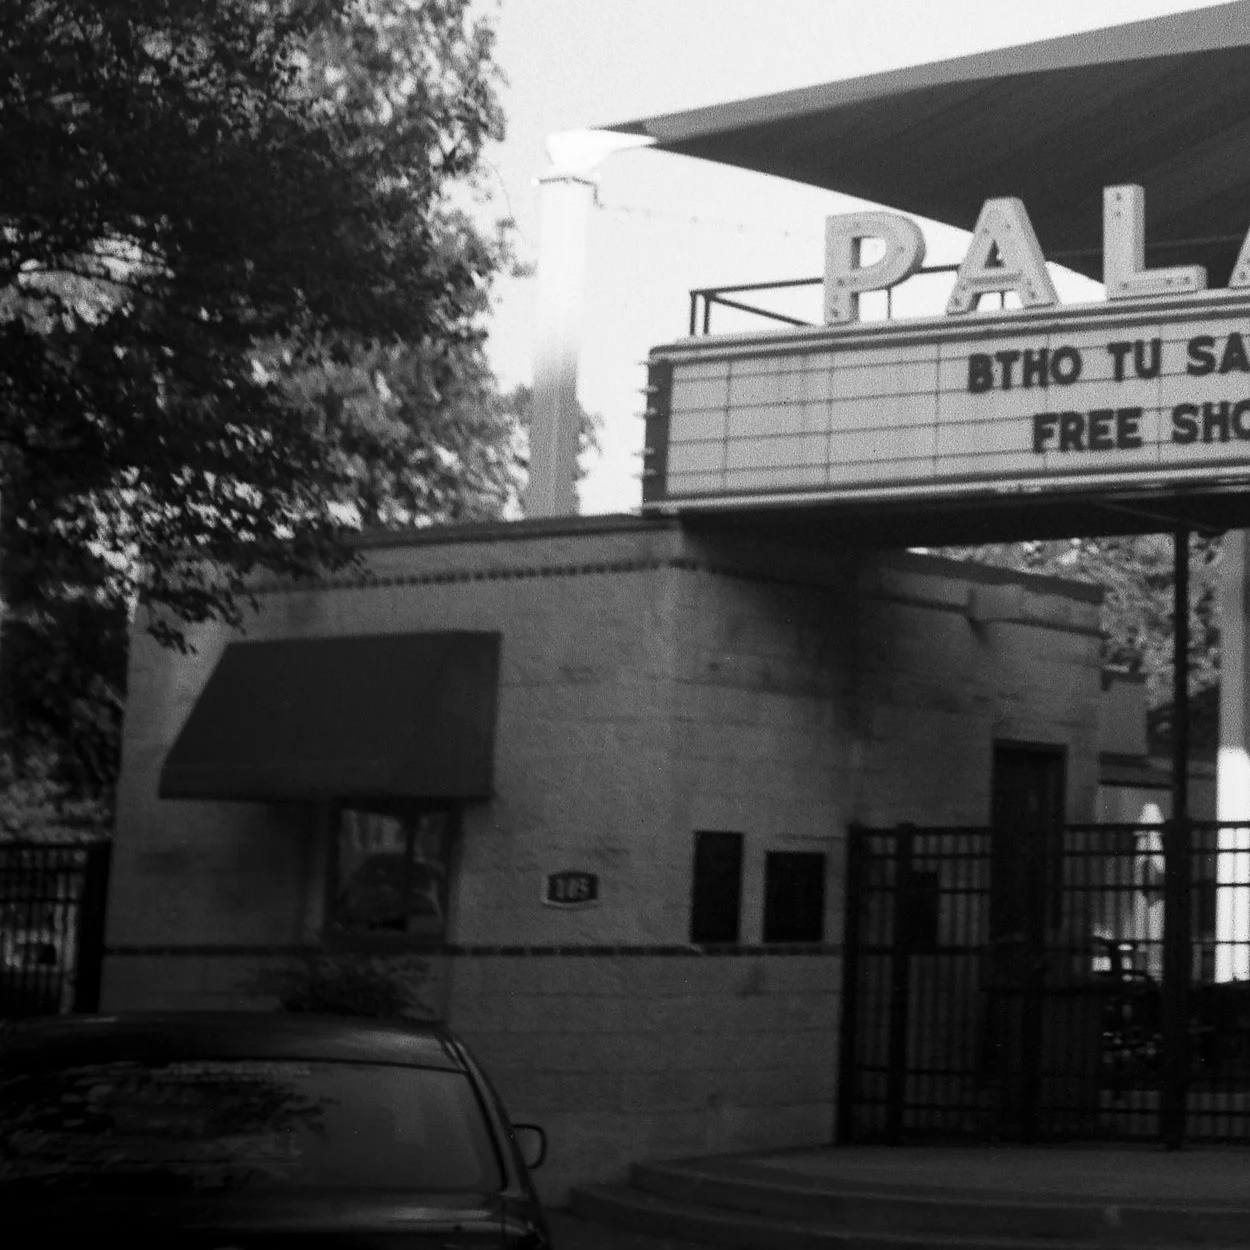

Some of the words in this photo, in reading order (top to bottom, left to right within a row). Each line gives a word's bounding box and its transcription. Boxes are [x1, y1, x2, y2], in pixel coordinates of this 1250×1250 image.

[967, 346, 1082, 393] BTHO
[1107, 338, 1161, 382] TU
[1033, 407, 1143, 453] FREE
